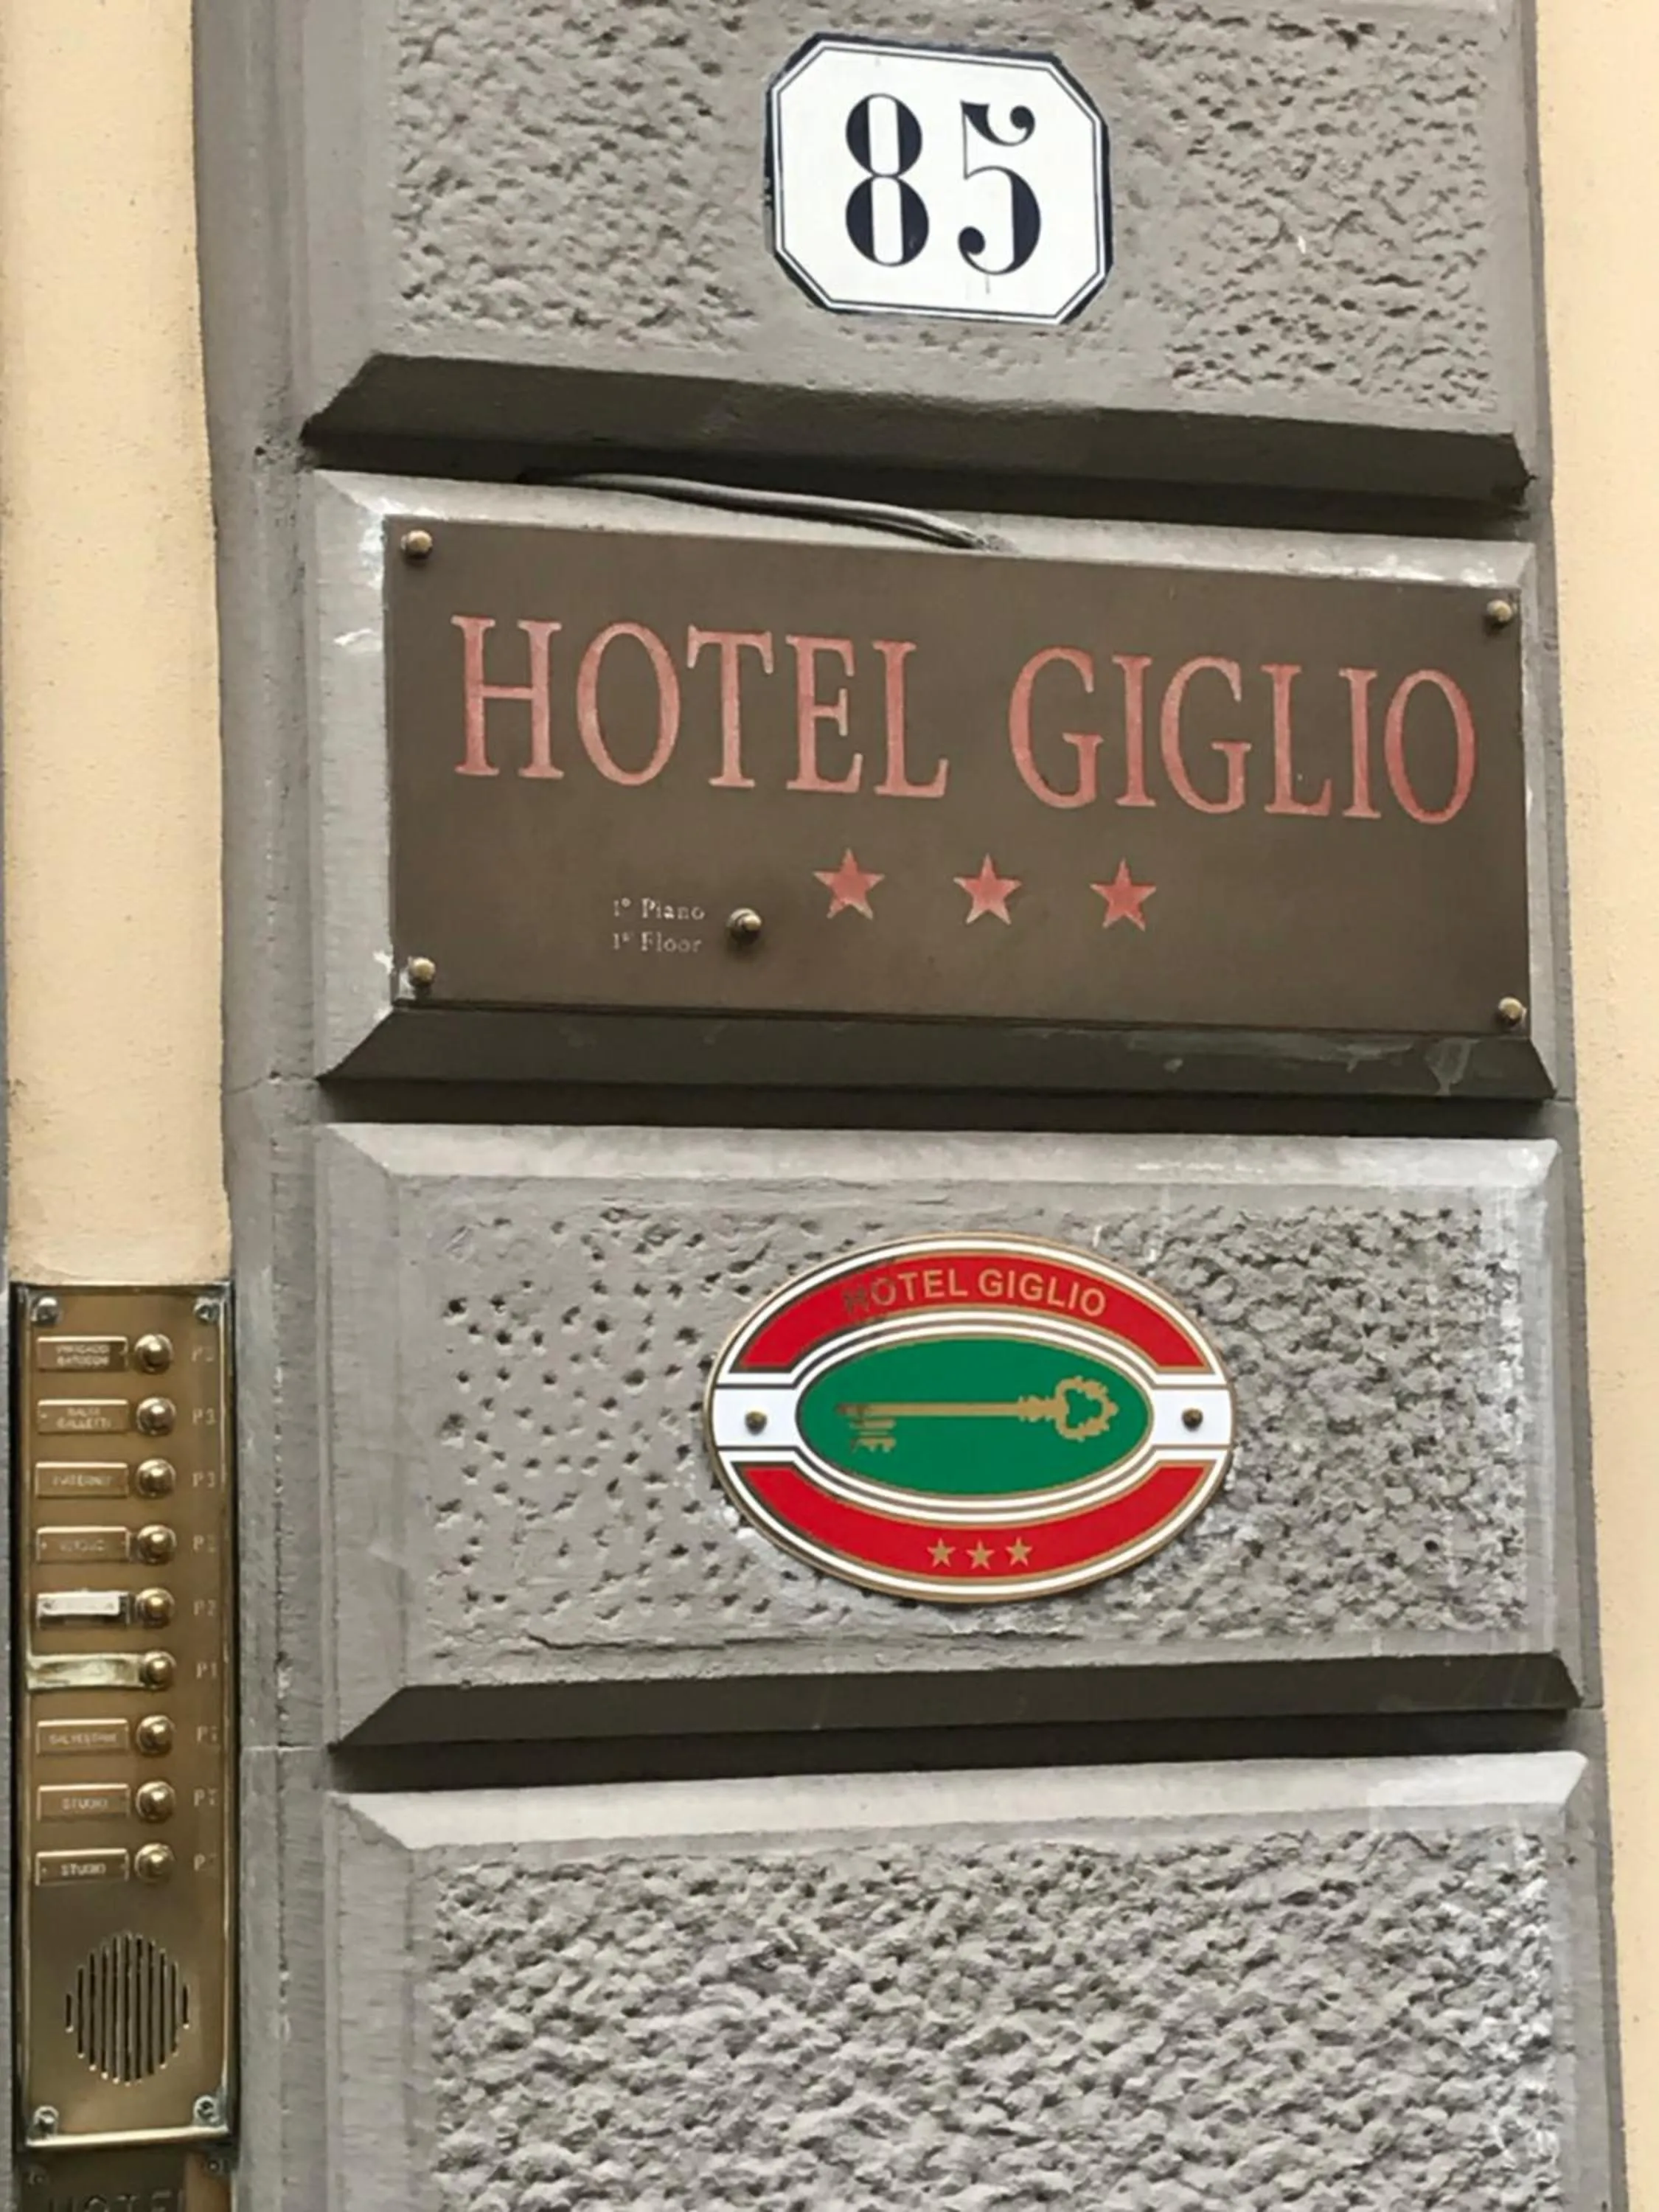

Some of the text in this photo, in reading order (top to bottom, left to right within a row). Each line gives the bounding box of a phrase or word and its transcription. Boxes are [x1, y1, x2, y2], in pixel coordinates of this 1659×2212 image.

[845, 92, 1041, 276] 85
[451, 613, 1475, 825] HOTEL GIGLIO
[641, 897, 705, 920] Piano
[641, 931, 702, 952] Floor
[842, 1268, 1106, 1317] HOTEL GIGLIO
